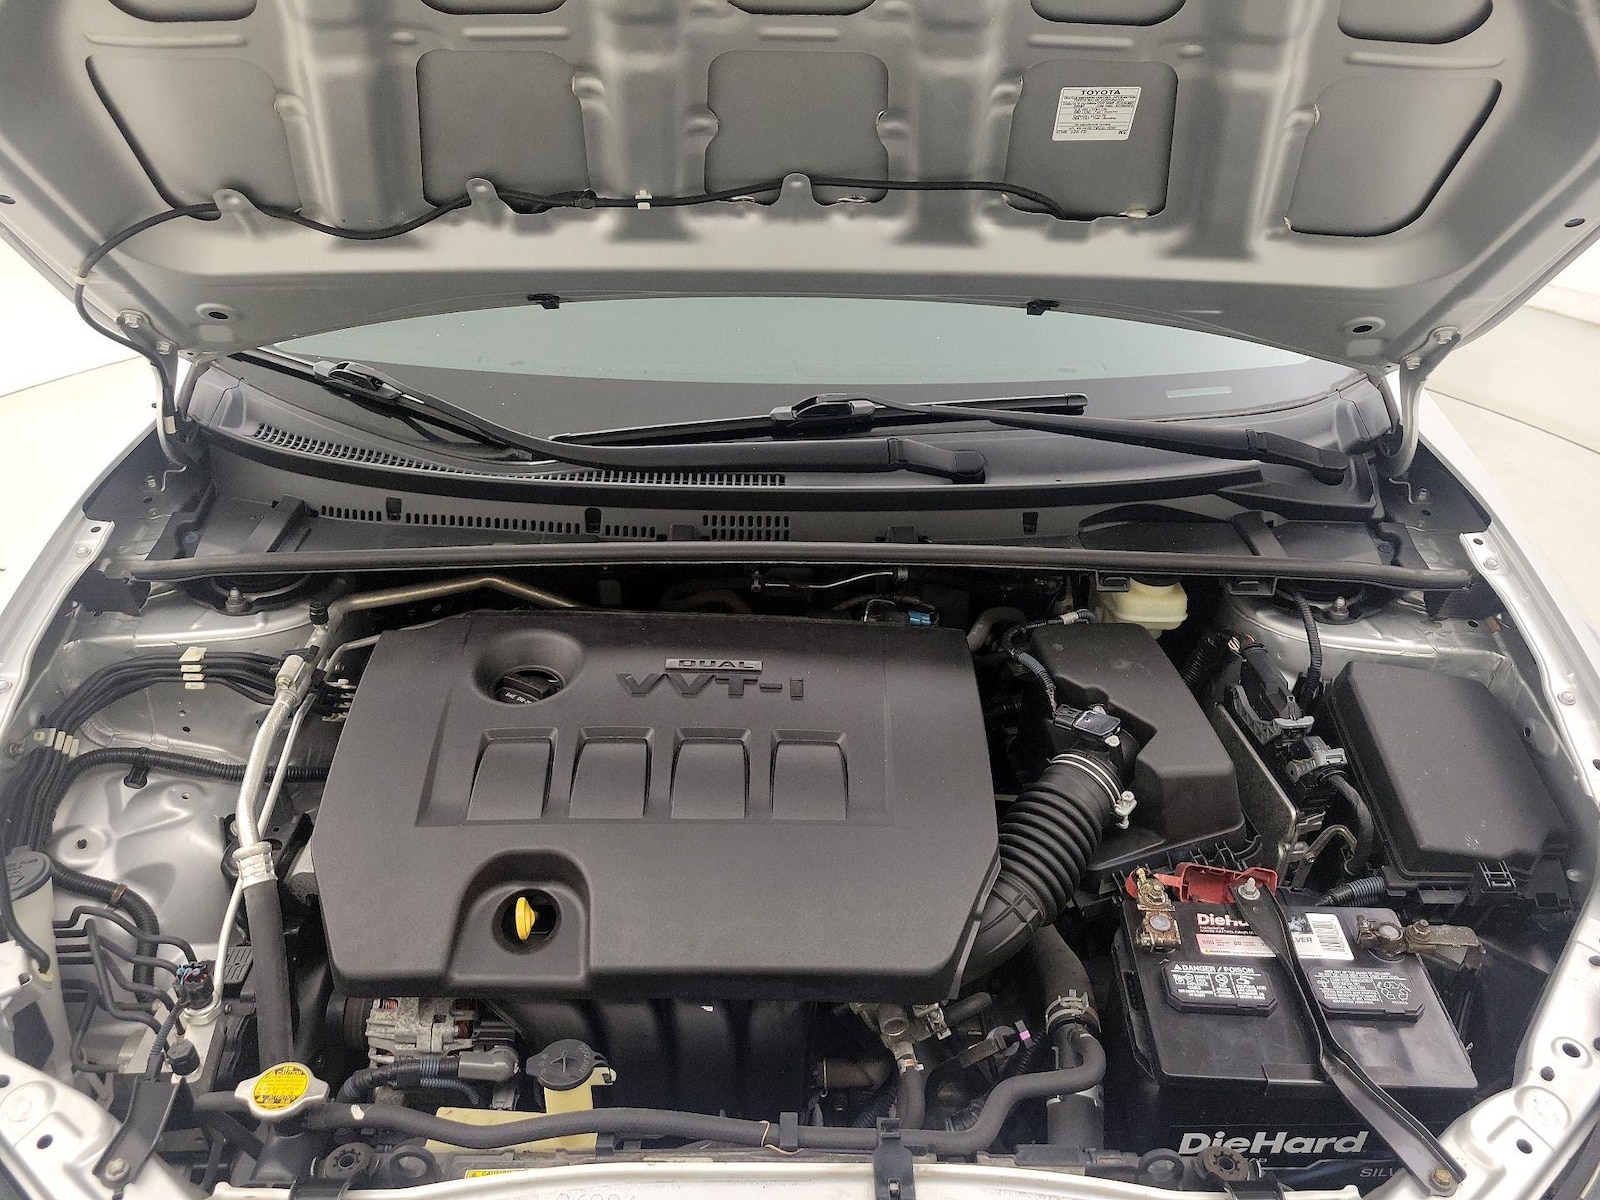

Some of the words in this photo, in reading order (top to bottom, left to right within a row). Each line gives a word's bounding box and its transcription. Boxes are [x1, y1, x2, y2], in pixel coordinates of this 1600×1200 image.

[678, 660, 754, 668] DUAL
[1182, 964, 1216, 973] DANGER
[1223, 966, 1255, 974] POISON
[1178, 1131, 1369, 1155] DieHard
